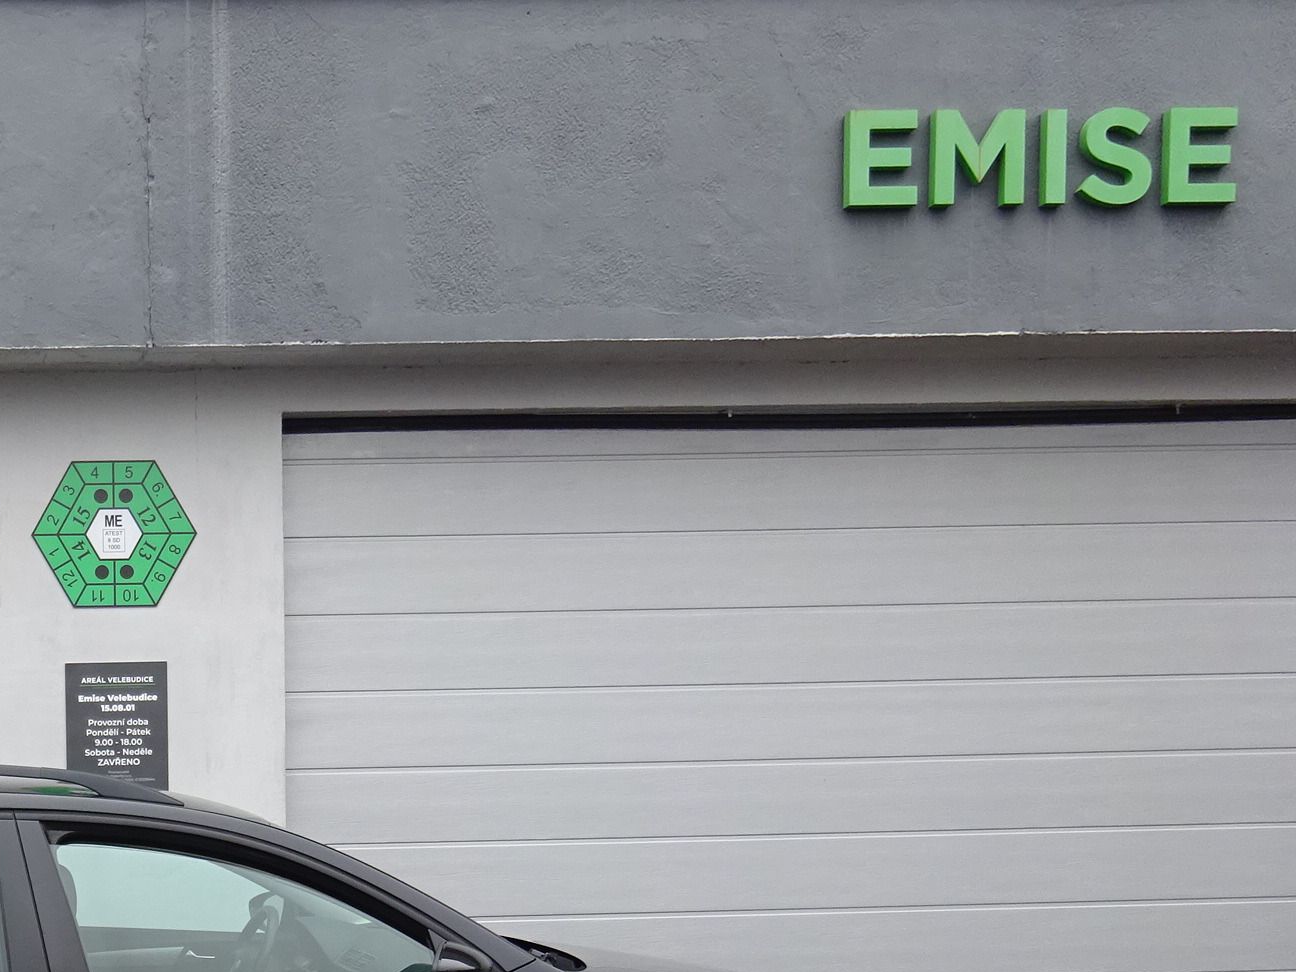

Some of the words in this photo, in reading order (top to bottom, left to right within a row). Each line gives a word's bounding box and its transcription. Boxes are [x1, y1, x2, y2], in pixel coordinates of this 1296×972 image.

[843, 107, 1238, 208] EMISE
[90, 466, 99, 478] 4
[125, 466, 133, 479] 5
[62, 484, 75, 496] 3
[46, 514, 59, 526] 2
[72, 505, 91, 527] 15
[104, 514, 122, 527] ME
[137, 506, 157, 527] 12
[169, 511, 182, 521] 7
[48, 547, 59, 557] 1
[71, 540, 91, 560] 14
[138, 540, 157, 561] 13
[168, 544, 181, 555] 8
[62, 569, 79, 588] 12
[92, 589, 104, 602] 11
[123, 589, 139, 602] 10
[81, 675, 106, 684] AREÁL
[78, 694, 105, 703] Emise
[107, 693, 158, 702] Velebudice
[101, 704, 135, 712] 15.08.01
[88, 718, 125, 727] Provozní
[127, 718, 149, 726] doba
[86, 728, 119, 737] Pondělí
[126, 728, 151, 736] Pátek
[120, 738, 143, 746] 18.00
[85, 749, 115, 757] Sobota
[122, 748, 153, 756] Neděle
[97, 756, 140, 767] ZAVŘENO
